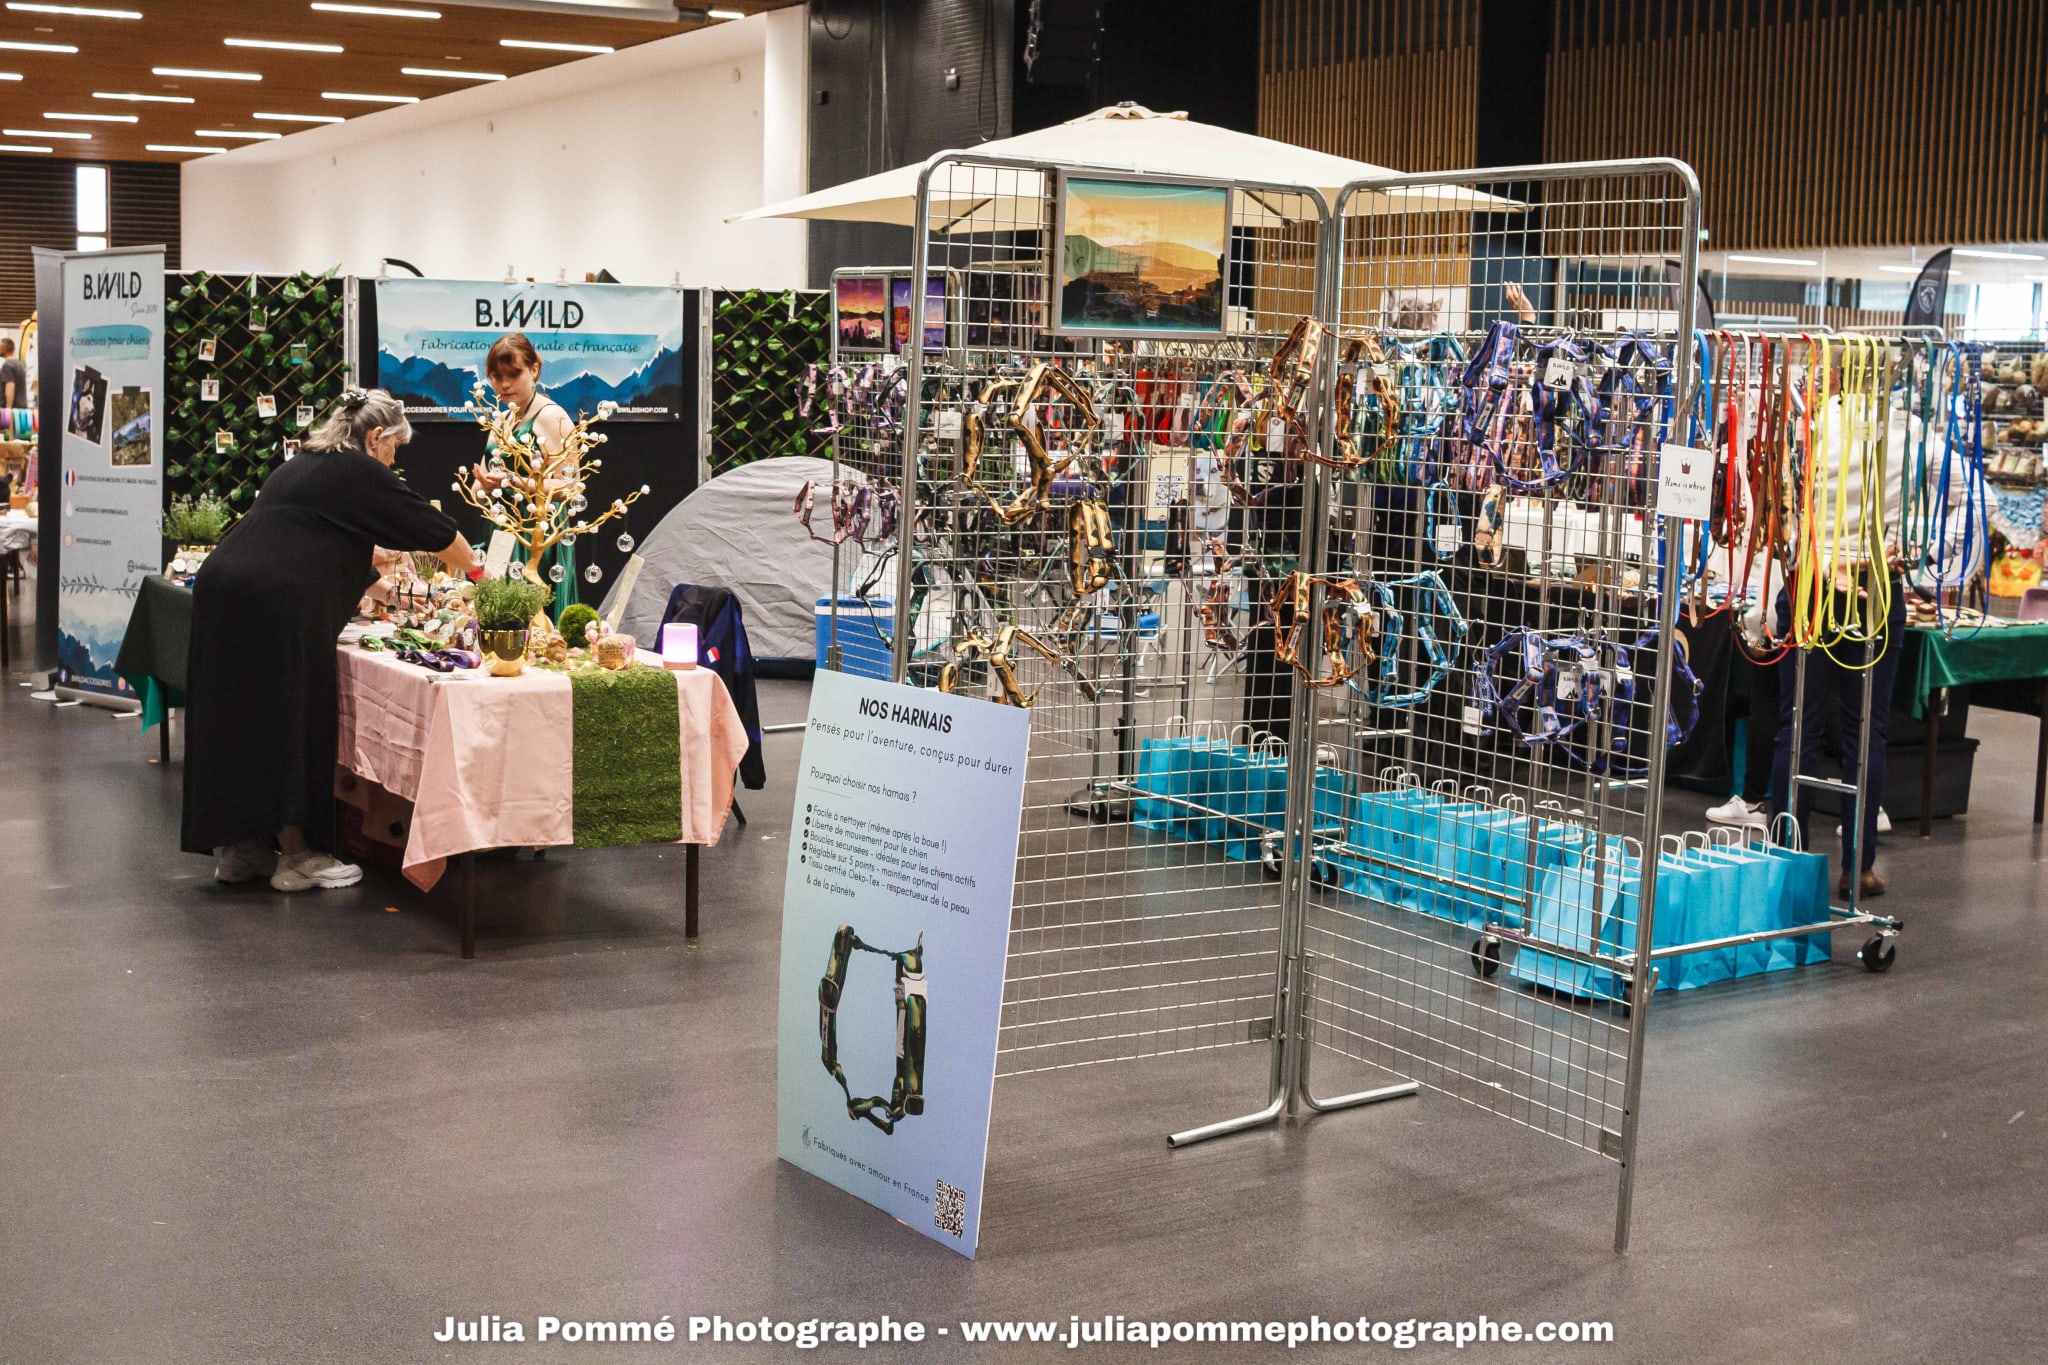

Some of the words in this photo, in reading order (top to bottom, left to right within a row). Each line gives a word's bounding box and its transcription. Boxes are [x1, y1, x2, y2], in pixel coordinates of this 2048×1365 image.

[84, 271, 141, 300] B.WILD
[476, 299, 584, 328] B.WILD
[569, 341, 580, 351] et
[582, 341, 639, 354] française
[859, 697, 888, 719] NOS
[891, 704, 952, 733] HARNAIS
[811, 718, 840, 735] Pensés
[843, 729, 864, 741] pour
[920, 746, 954, 763] conçus
[958, 755, 981, 767] pour
[984, 757, 1012, 775] durer
[810, 767, 841, 784] Pourquoi
[842, 776, 866, 790] choisir
[868, 784, 880, 794] nos
[882, 784, 910, 802] harnais
[912, 791, 917, 803] ?
[812, 818, 833, 832] Liberté
[835, 825, 843, 835] de
[845, 830, 882, 846] mouvement
[884, 841, 899, 852] pour
[901, 842, 907, 853] le
[909, 846, 928, 859] chien
[813, 805, 832, 818] Facile
[834, 811, 839, 820] à
[840, 815, 866, 829] nettoyer
[868, 819, 890, 835] (même
[893, 829, 911, 841] après
[913, 832, 919, 844] la
[922, 835, 939, 849] boue
[809, 843, 836, 860] Réglable
[838, 855, 847, 863] sur
[849, 856, 854, 865] 5
[855, 859, 874, 871] points
[882, 867, 910, 882] maintien
[912, 877, 939, 891] optimal
[810, 831, 834, 846] Boucles
[836, 840, 868, 856] sécurisées
[876, 851, 899, 865] idéales
[901, 860, 917, 870] pour
[919, 862, 928, 874] les
[930, 866, 953, 881] chiens
[955, 876, 976, 888] actifs
[806, 874, 810, 883] &
[813, 878, 821, 887] de
[823, 878, 828, 889] la
[831, 882, 855, 897] planète
[808, 856, 822, 869] Tissu
[824, 865, 846, 876] certifié
[887, 883, 928, 901] respectueux
[930, 894, 939, 905] de
[942, 896, 948, 908] la
[951, 903, 969, 915] peau
[813, 1137, 847, 1162] Fabriqués
[849, 1158, 866, 1172] avec
[868, 1167, 890, 1184] amour
[893, 1180, 901, 1190] en
[904, 1182, 930, 1204] France
